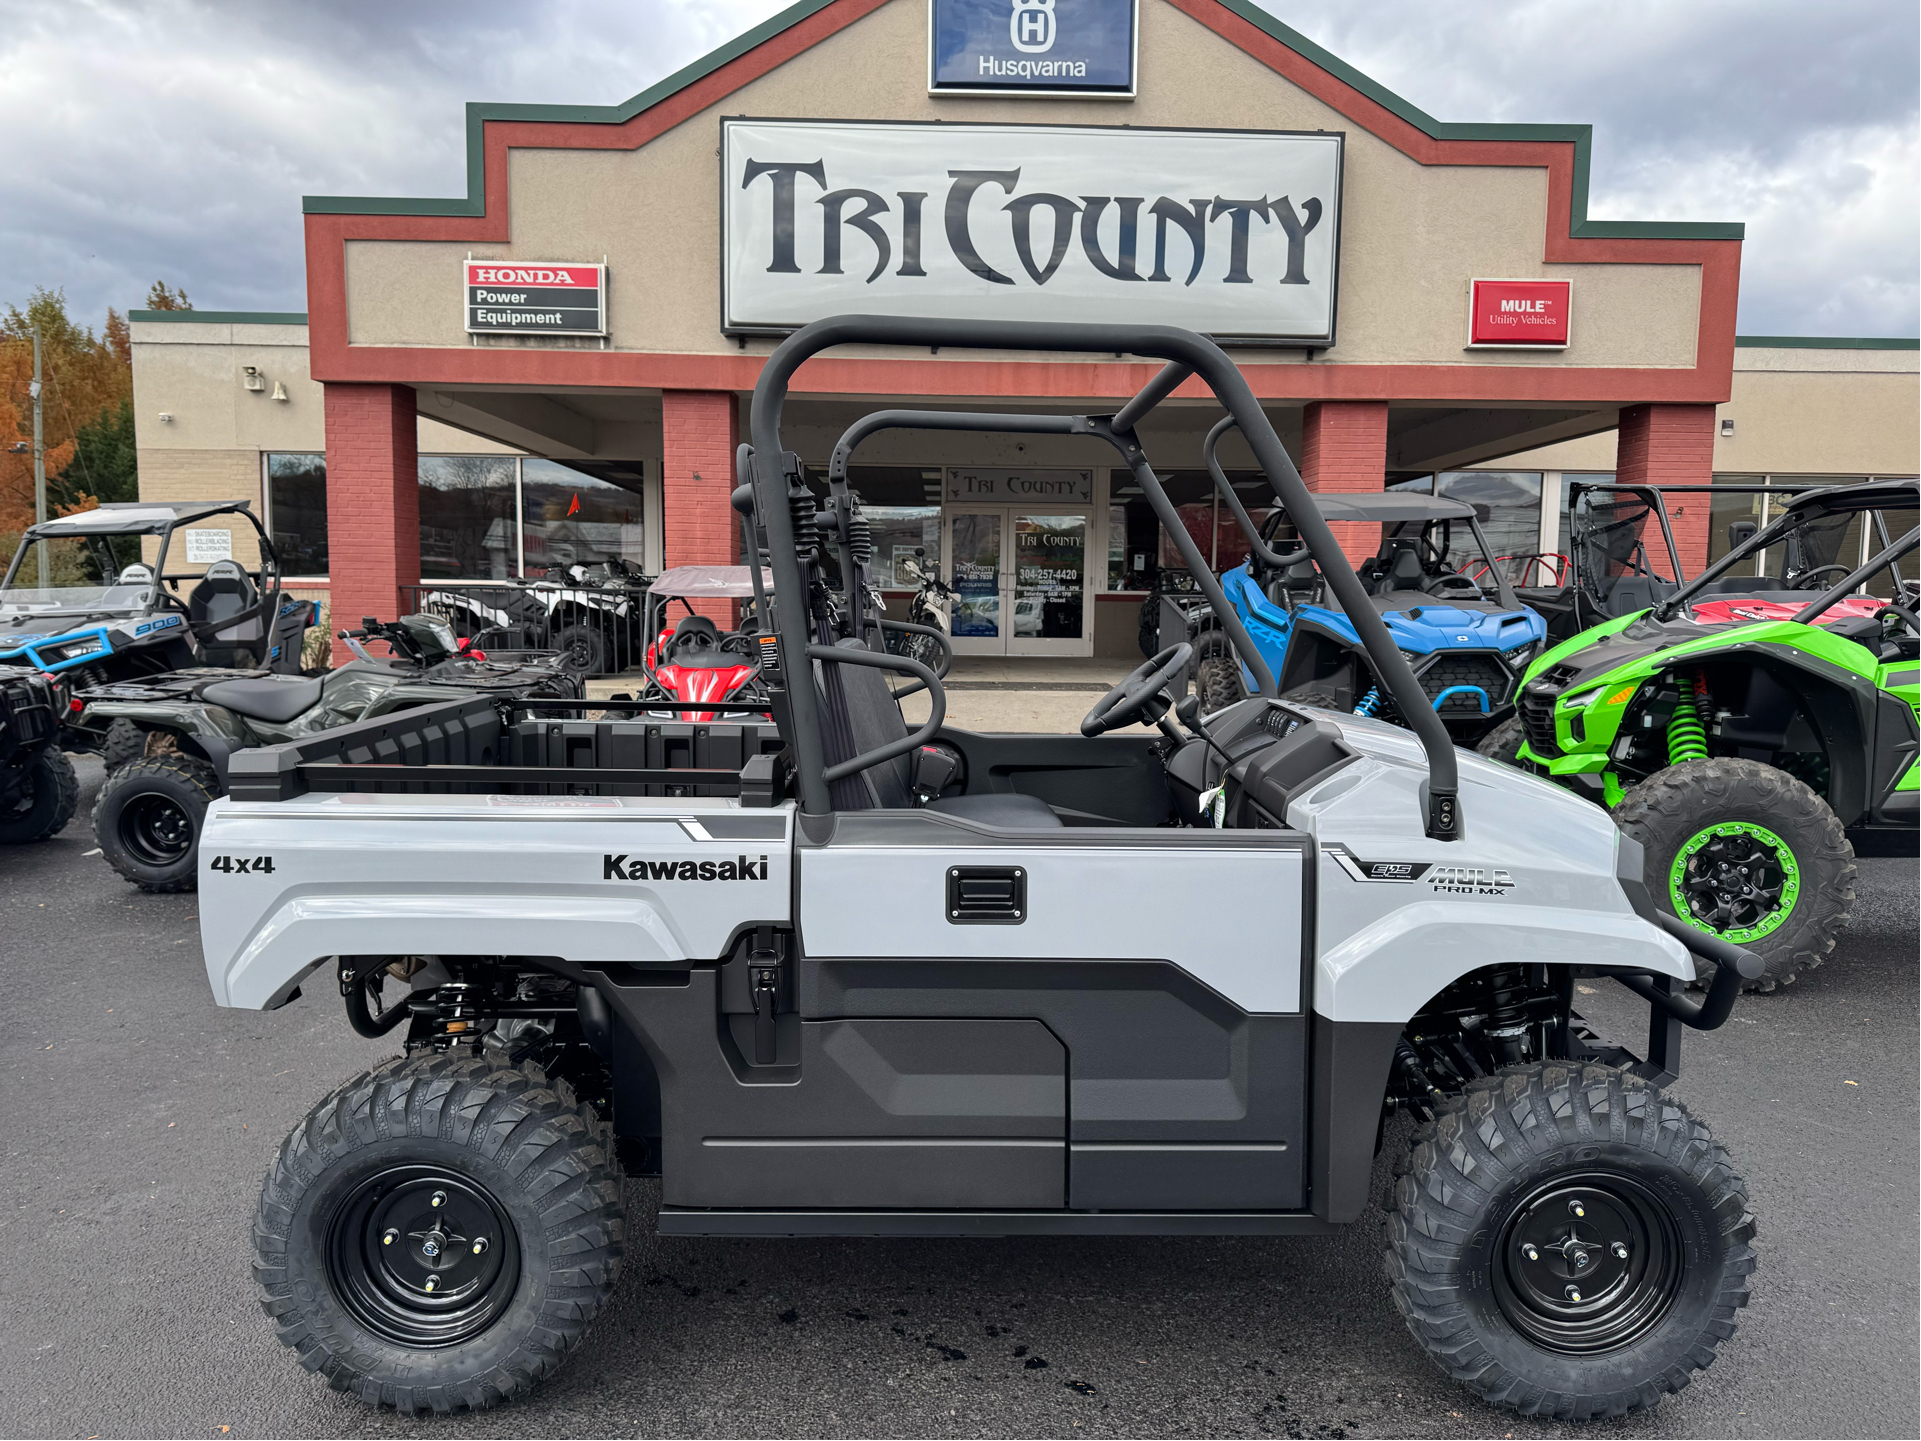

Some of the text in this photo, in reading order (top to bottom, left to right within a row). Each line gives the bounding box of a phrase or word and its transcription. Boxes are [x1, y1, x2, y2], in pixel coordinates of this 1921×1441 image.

[979, 56, 1086, 79] Husqvarna
[741, 157, 1322, 287] TRI COUNTY
[476, 269, 575, 284] HONDA
[476, 290, 527, 303] Power
[477, 309, 562, 326] Equipment
[1489, 315, 1557, 326] Utility Vehicles
[964, 476, 1076, 495] TRI COUNTY
[1020, 534, 1081, 546] TRI COUNTY
[1020, 569, 1077, 580] 304-257-4420
[135, 615, 181, 636] 900
[1243, 616, 1287, 649] RZR
[210, 856, 276, 874] 4x4
[603, 854, 768, 880] Kawasaki
[1426, 866, 1516, 887] MULE
[1433, 886, 1506, 895] PRO-MX
